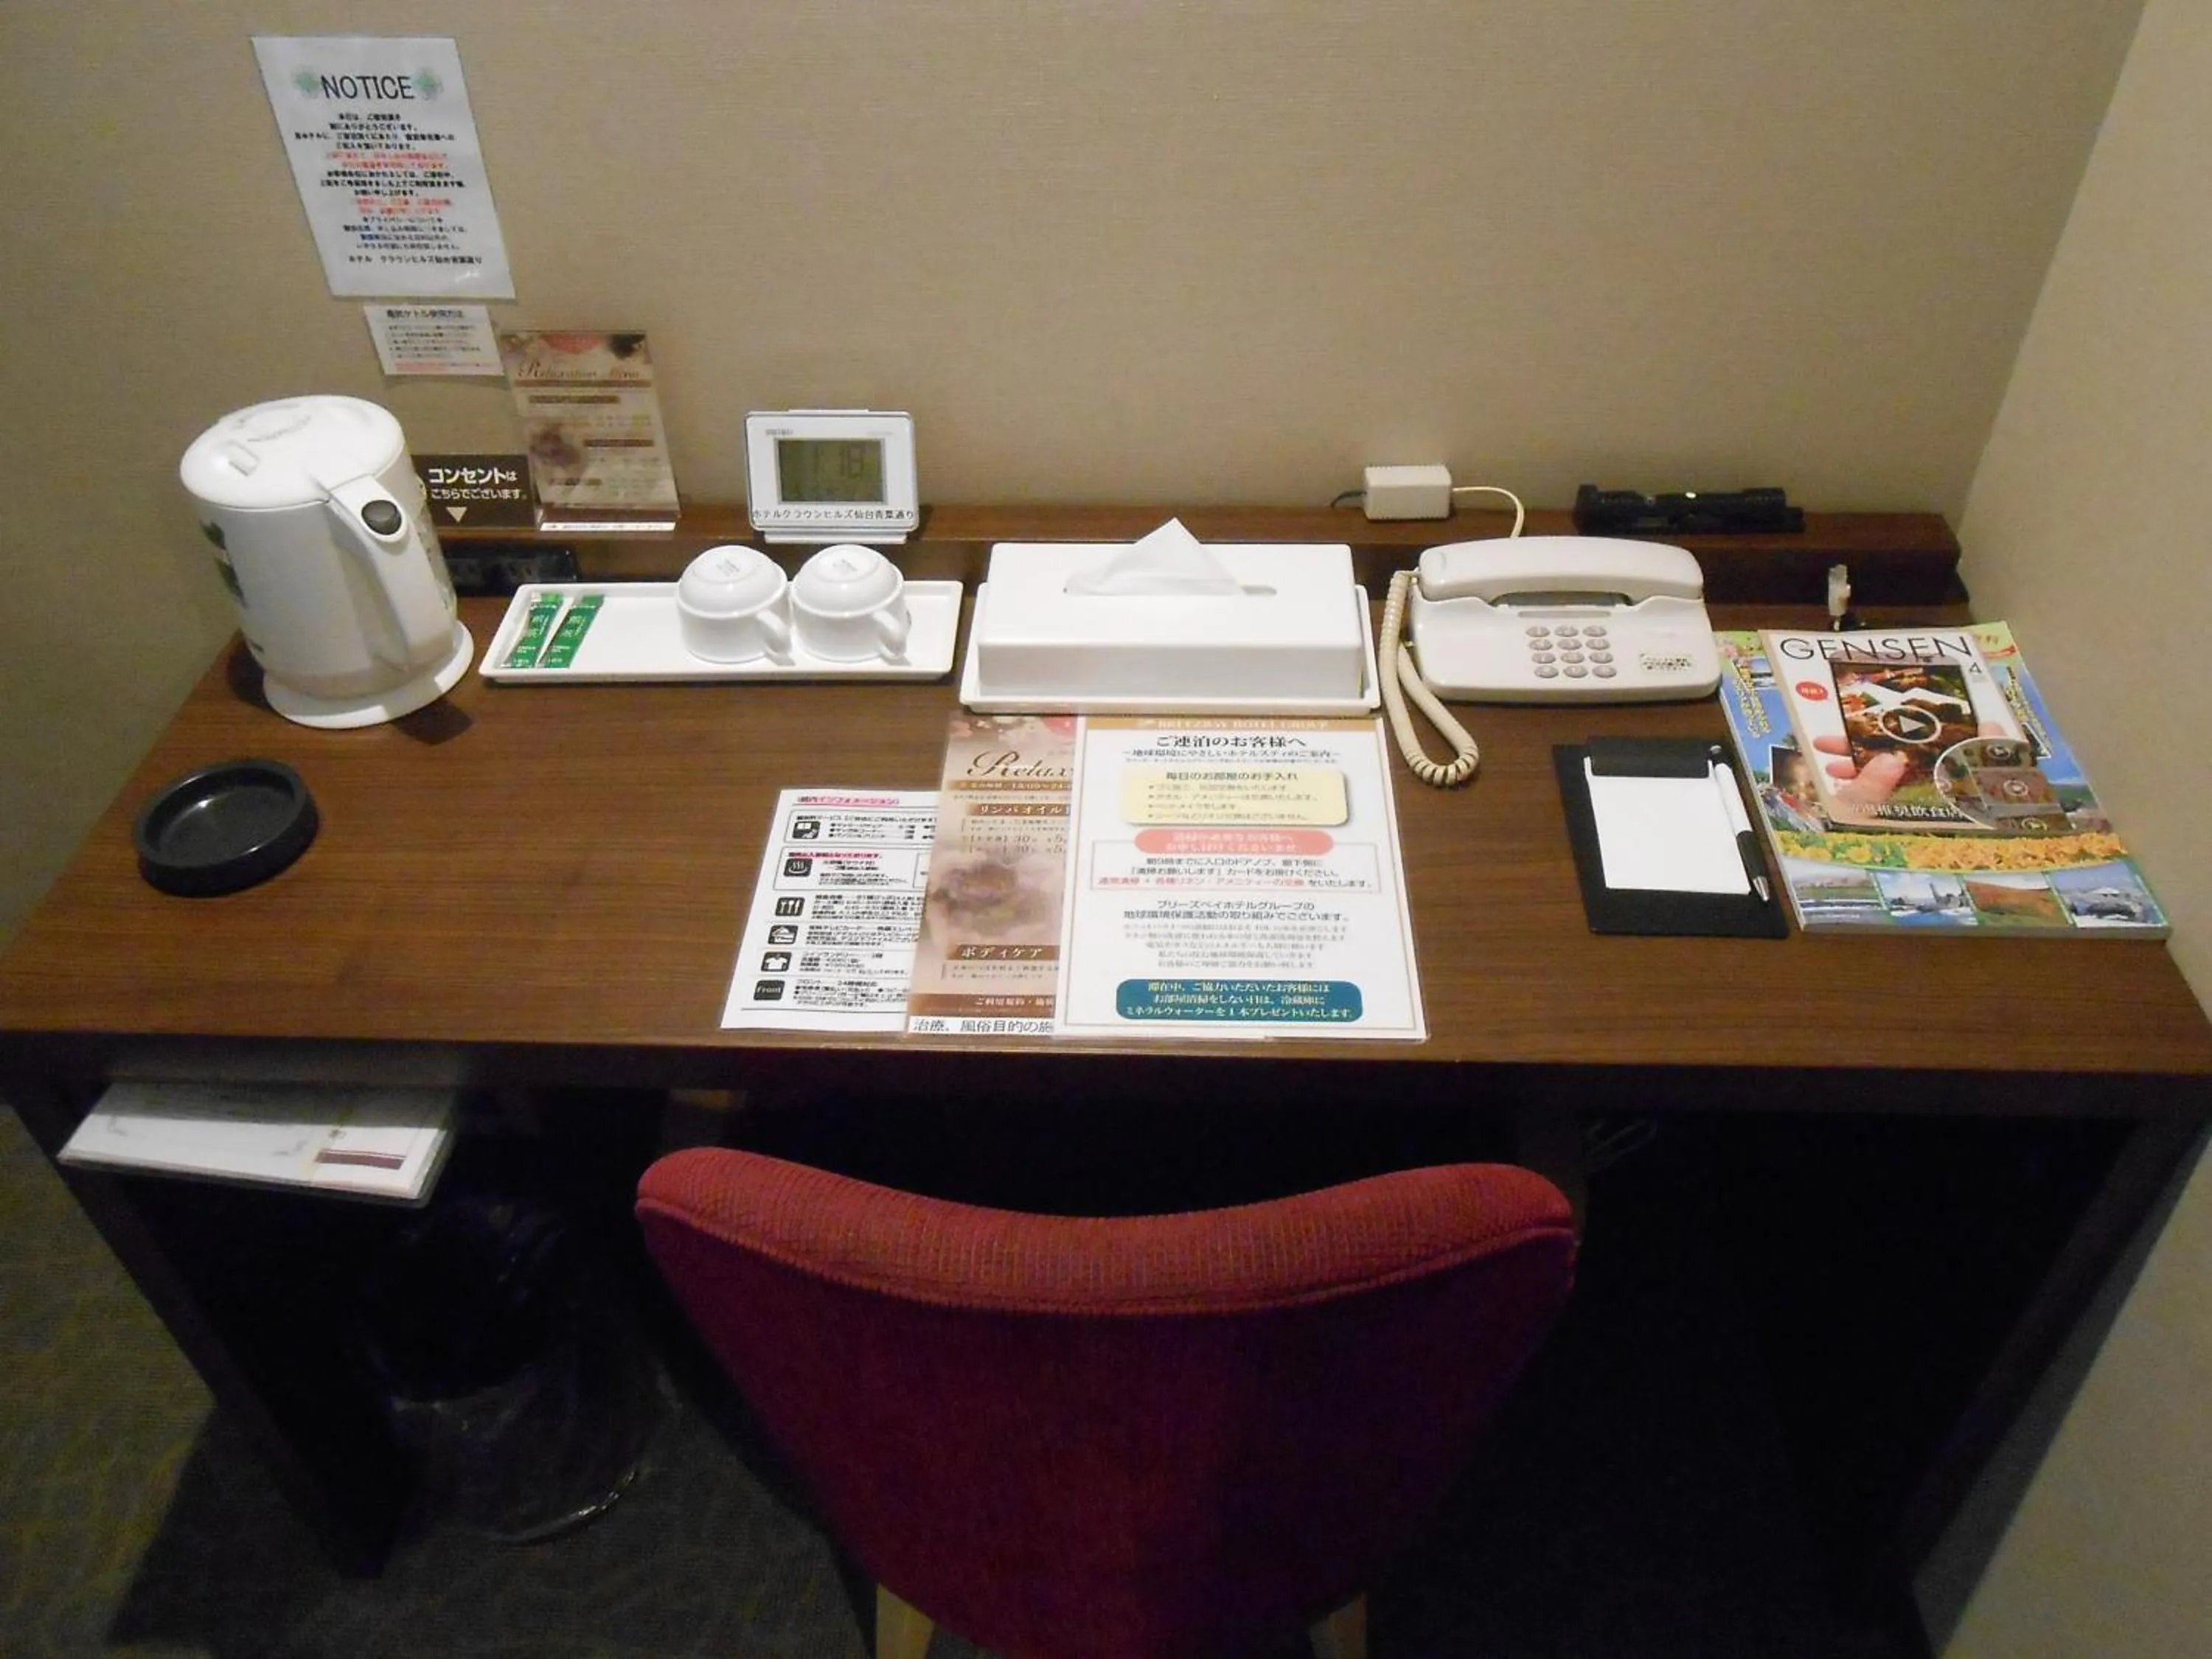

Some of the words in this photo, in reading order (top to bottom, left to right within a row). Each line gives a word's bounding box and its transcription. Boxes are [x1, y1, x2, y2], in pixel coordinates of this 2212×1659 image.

[320, 75, 415, 99] NOTICE
[428, 467, 518, 484] コンセントは
[431, 488, 527, 500] こちらでございます。
[753, 509, 914, 520] ホテルクラウンヒルズ仙台青葉通り
[1779, 636, 1972, 661] GENSEN
[1156, 735, 1307, 748] ご連泊のお客様へ
[1166, 771, 1298, 781] 毎日のお部屋のお手入れ
[961, 947, 1043, 959] ボディケア
